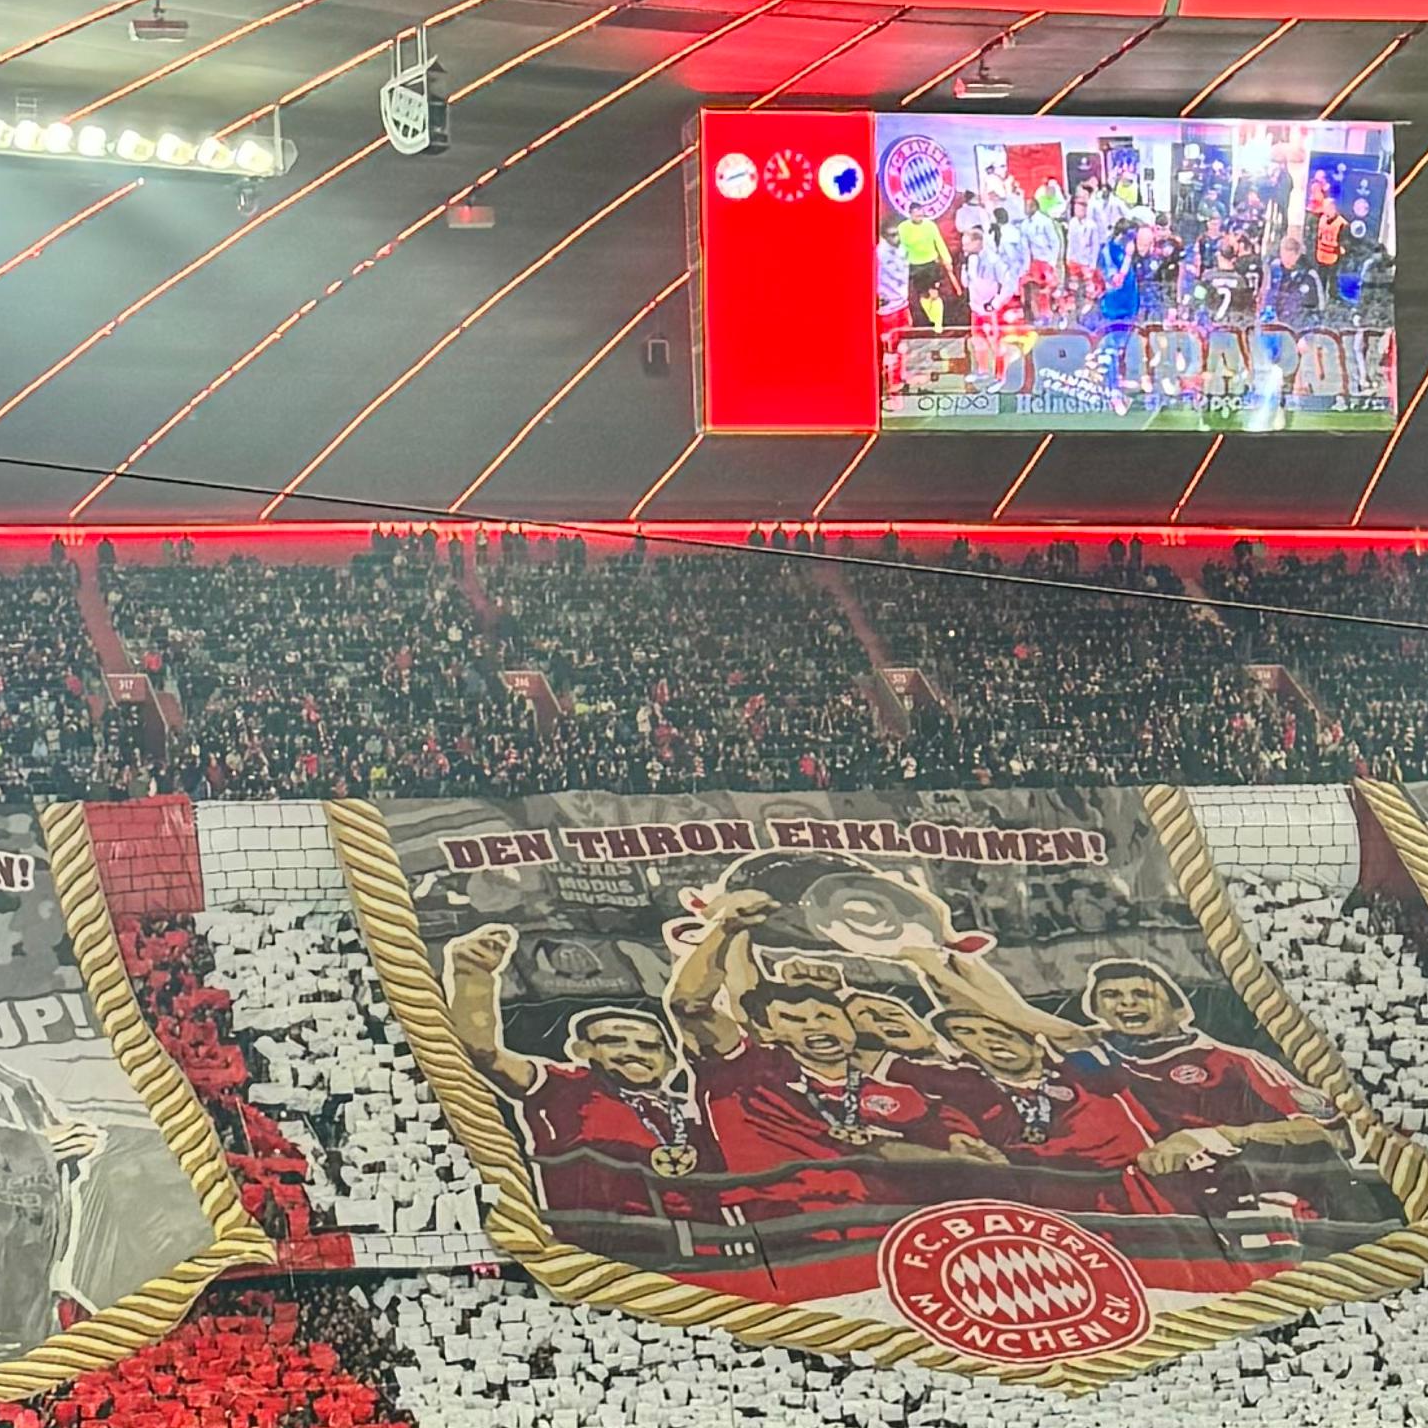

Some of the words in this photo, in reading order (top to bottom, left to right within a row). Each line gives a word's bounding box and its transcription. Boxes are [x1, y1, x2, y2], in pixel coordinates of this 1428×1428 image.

[918, 393, 989, 414] oppo
[442, 830, 556, 870] DEN
[564, 820, 756, 861] THRON
[771, 820, 1106, 864] ERKLOMMEN!
[557, 876, 635, 895] MODUS
[941, 1213, 1111, 1271] BAYERN
[909, 1292, 1113, 1354] MÜNCHEN
